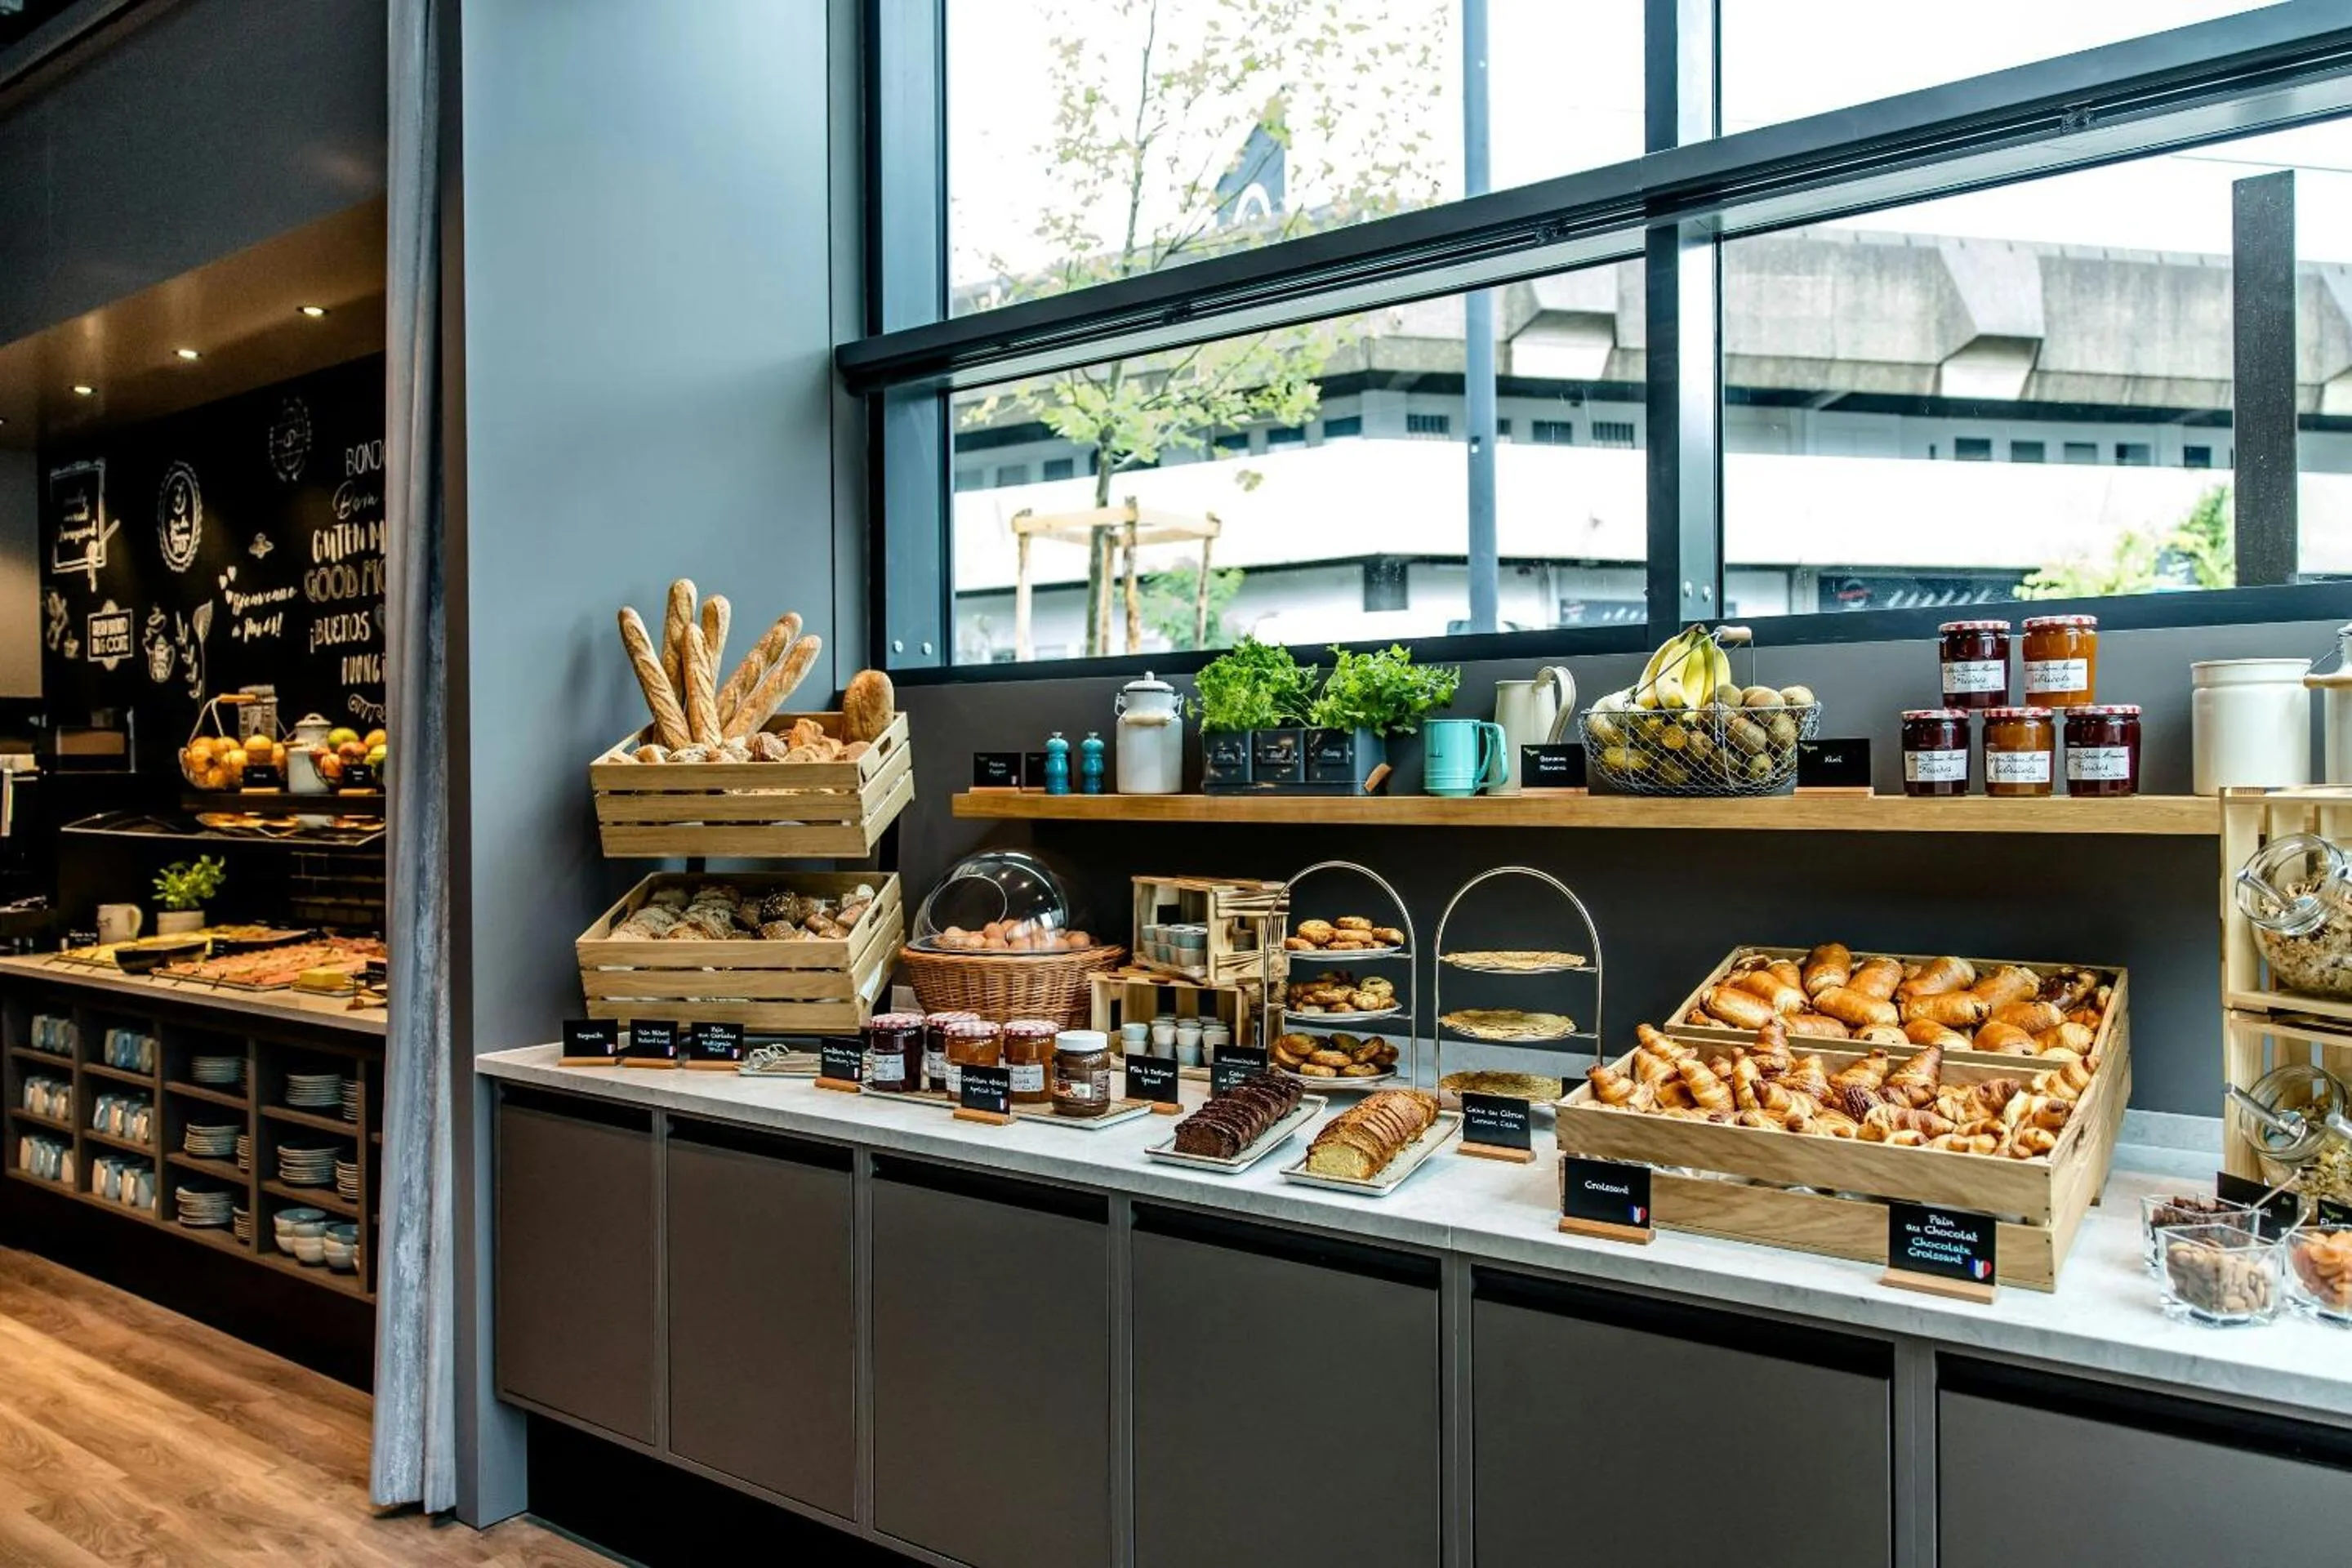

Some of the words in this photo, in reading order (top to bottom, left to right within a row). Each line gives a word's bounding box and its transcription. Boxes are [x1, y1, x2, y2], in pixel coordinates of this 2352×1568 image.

[305, 564, 359, 603] GOOD
[1584, 1180, 1630, 1196] Croissant
[1928, 1214, 1955, 1227] Pain
[1905, 1223, 1922, 1232] au
[1924, 1225, 1979, 1242] Chocolat
[1912, 1236, 1972, 1255] Chocolate
[1907, 1247, 1964, 1264] Croissant
